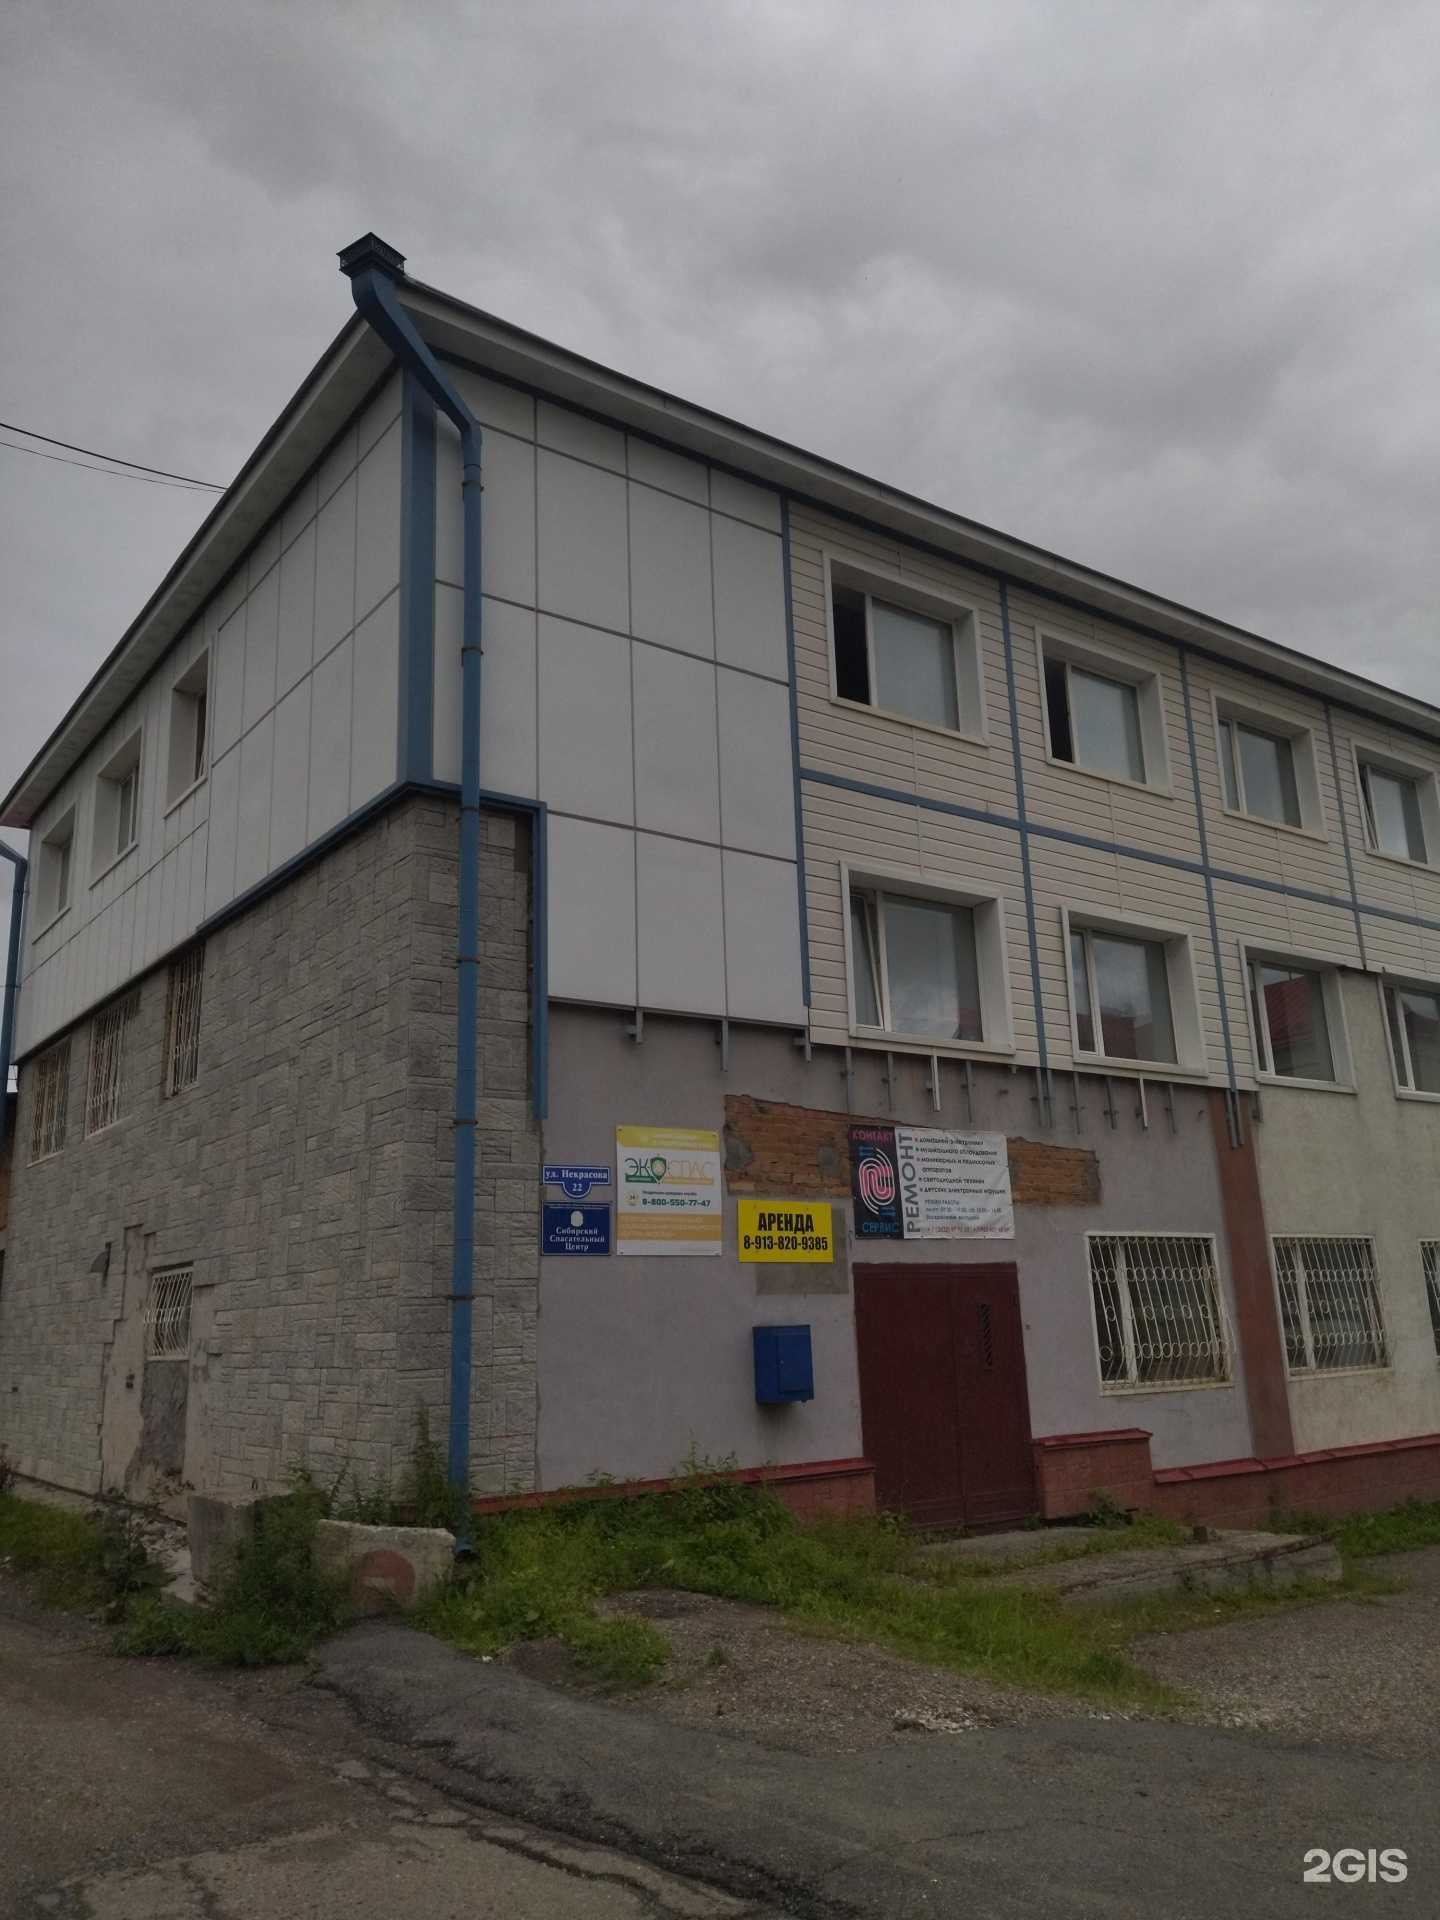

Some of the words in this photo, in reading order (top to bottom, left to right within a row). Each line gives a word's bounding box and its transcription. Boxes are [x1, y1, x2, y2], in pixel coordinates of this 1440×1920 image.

[852, 1130, 894, 1144] КОНТАКТ
[545, 1170, 559, 1179] ул.
[561, 1170, 608, 1180] Некрасова
[572, 1183, 583, 1192] 22
[898, 1133, 921, 1233] РЕМОНТ
[758, 1213, 814, 1233] АРЕНДА
[862, 1222, 898, 1233] СЕРВИС
[555, 1227, 598, 1236] Сибирский
[549, 1235, 605, 1243] Спасательный
[743, 1235, 828, 1251] 8-913-820-9385
[565, 1242, 589, 1251] Центр
